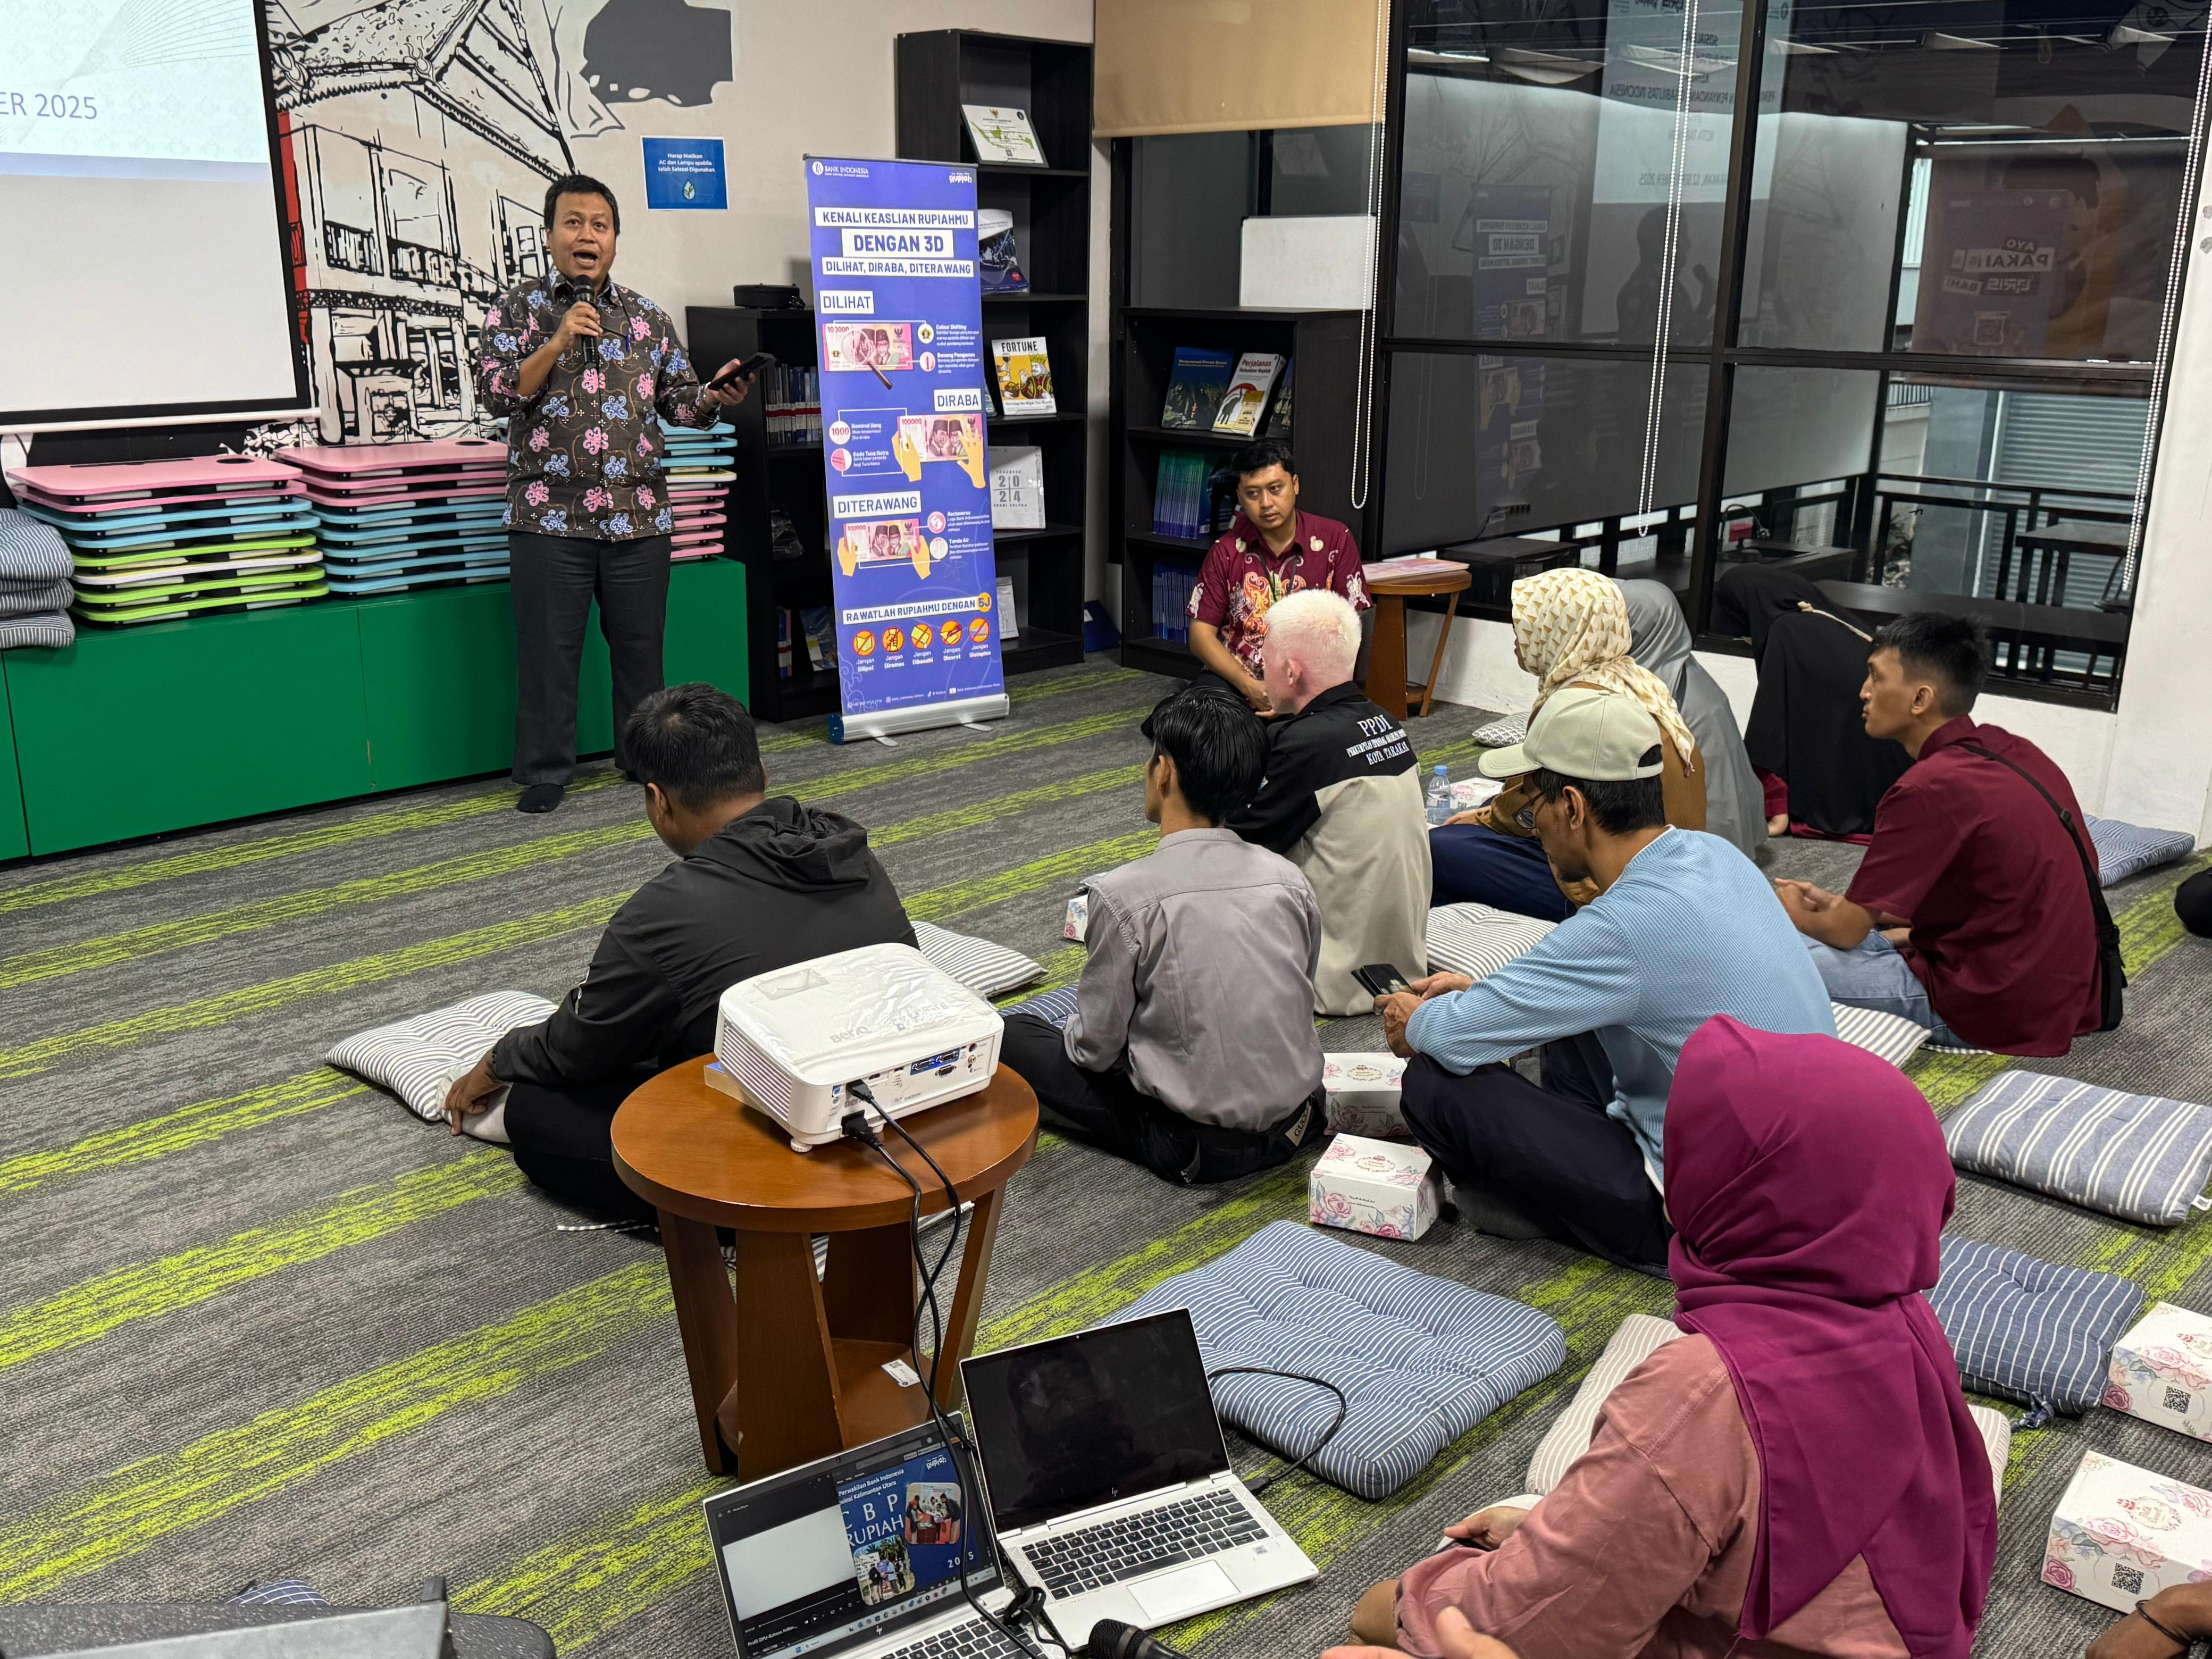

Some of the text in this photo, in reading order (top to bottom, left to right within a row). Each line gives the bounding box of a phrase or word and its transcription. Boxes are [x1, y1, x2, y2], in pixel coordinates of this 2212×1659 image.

[35, 94, 97, 119] 2025
[840, 166, 869, 175] INDONESIA
[823, 211, 861, 223] KENALI
[865, 212, 916, 224] KEASLIAN
[918, 214, 968, 225] RUPIAHMU
[853, 234, 944, 252] DENGAN 3D
[826, 261, 971, 274] DILIHAT, DIRABA, DITERAWANG
[824, 296, 870, 309] DILIHAT
[1001, 341, 1038, 353] FORTUNE
[937, 394, 979, 407] DIRABA
[999, 475, 1020, 487] 2 0
[1000, 490, 1020, 502] 2 4
[838, 497, 917, 513] DITERAWANG
[846, 596, 991, 622] RAWATLAH RUPIAHMU DENGAN 5J
[1357, 714, 1393, 738] PPDI
[1366, 750, 1385, 765] KOTA
[838, 1482, 867, 1497] Perwakilan
[867, 1478, 880, 1486] Bank
[880, 1469, 904, 1481] Indonesia
[862, 1503, 876, 1522] B
[887, 1494, 899, 1513] P
